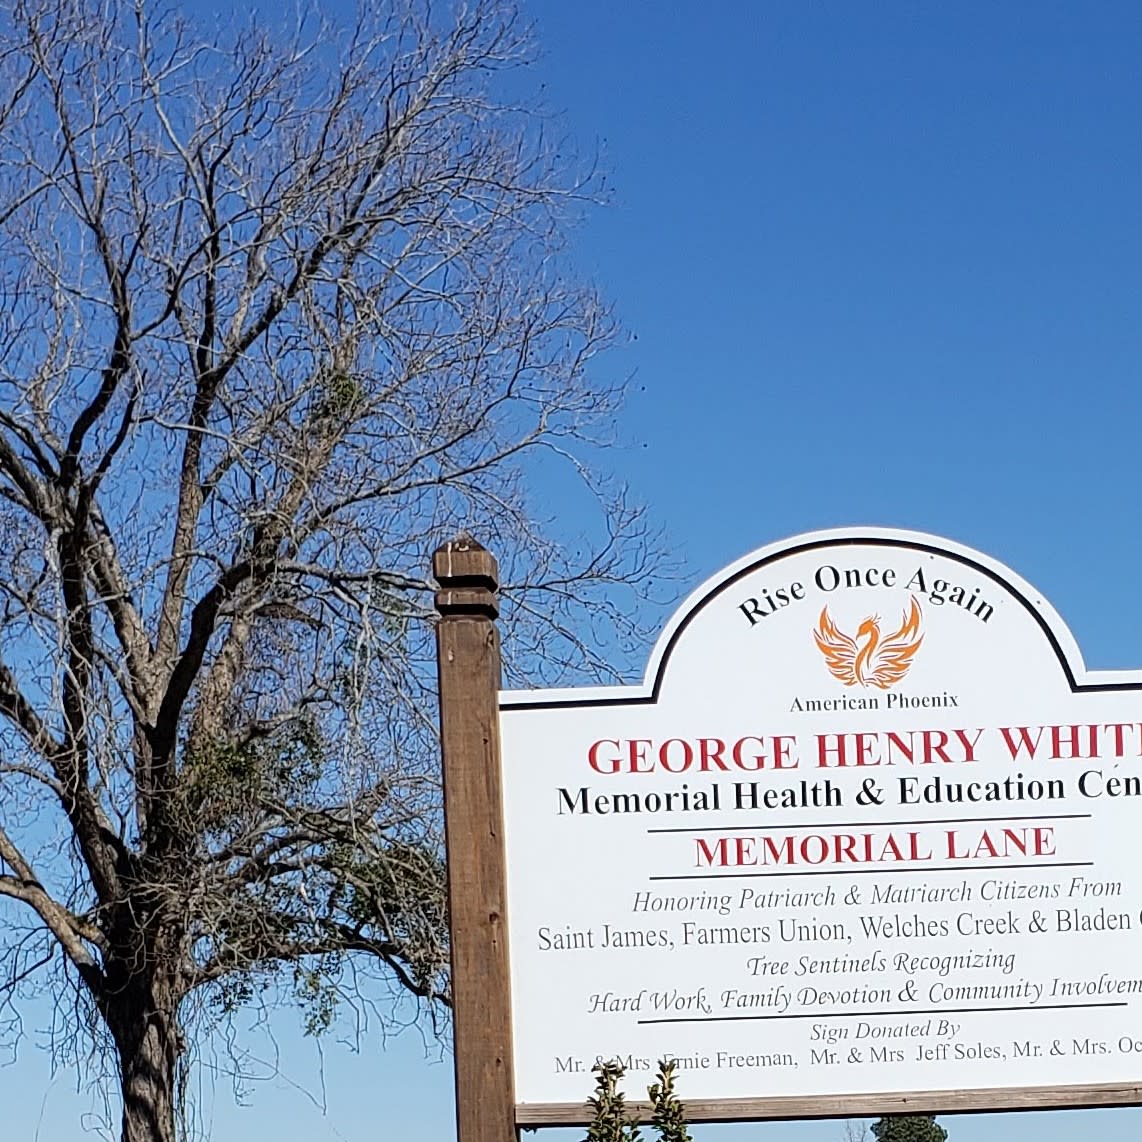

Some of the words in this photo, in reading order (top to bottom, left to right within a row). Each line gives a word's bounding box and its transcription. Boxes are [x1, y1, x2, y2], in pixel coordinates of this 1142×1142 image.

[737, 582, 806, 628] Rise
[815, 565, 896, 592] Once
[904, 566, 993, 624] Again
[790, 694, 878, 712] American
[887, 692, 959, 708] Phoenix
[588, 736, 799, 774] GEORGE
[813, 728, 985, 768] HENRY
[556, 784, 722, 815] Memorial
[731, 780, 844, 810] Health
[856, 778, 885, 806] &
[896, 773, 1066, 805] Education
[693, 832, 932, 867] MEMORIAL
[944, 827, 1056, 859] LANE
[632, 891, 732, 915] Honoring
[738, 885, 835, 909] Patriarch
[844, 885, 862, 905] &
[870, 881, 971, 904] Matriarch
[981, 880, 1060, 900] Citizens
[1067, 877, 1121, 897] From
[539, 926, 595, 950] Saint
[601, 925, 674, 951] James,
[681, 922, 770, 945] Farmers
[777, 917, 852, 945] Union,
[858, 914, 949, 939] Welches
[957, 910, 1021, 935] Creek
[1029, 910, 1048, 933] &
[1055, 907, 1132, 932] Bladen
[747, 955, 789, 976] Tree
[794, 950, 886, 976] Sentinels
[893, 948, 1015, 976] Recognizing
[587, 990, 647, 1013] Hard
[649, 988, 712, 1014] Work,
[721, 985, 791, 1013] Family
[797, 984, 890, 1005] Devotion
[898, 980, 919, 1002] &
[929, 978, 1043, 1004] Community
[810, 1024, 848, 1044] Sign
[855, 1020, 931, 1039] Donated
[936, 1020, 960, 1040] By
[555, 1056, 585, 1072] Mr.
[716, 1052, 798, 1069] Freeman,
[810, 1049, 840, 1064] Mr.
[847, 1047, 863, 1063] &
[869, 1046, 904, 1063] Mrs
[916, 1044, 950, 1061] Jeff
[955, 1042, 1006, 1061] Soles,
[1013, 1041, 1042, 1057] Mr.
[1050, 1040, 1066, 1056] &
[1072, 1039, 1111, 1055] Mrs.
